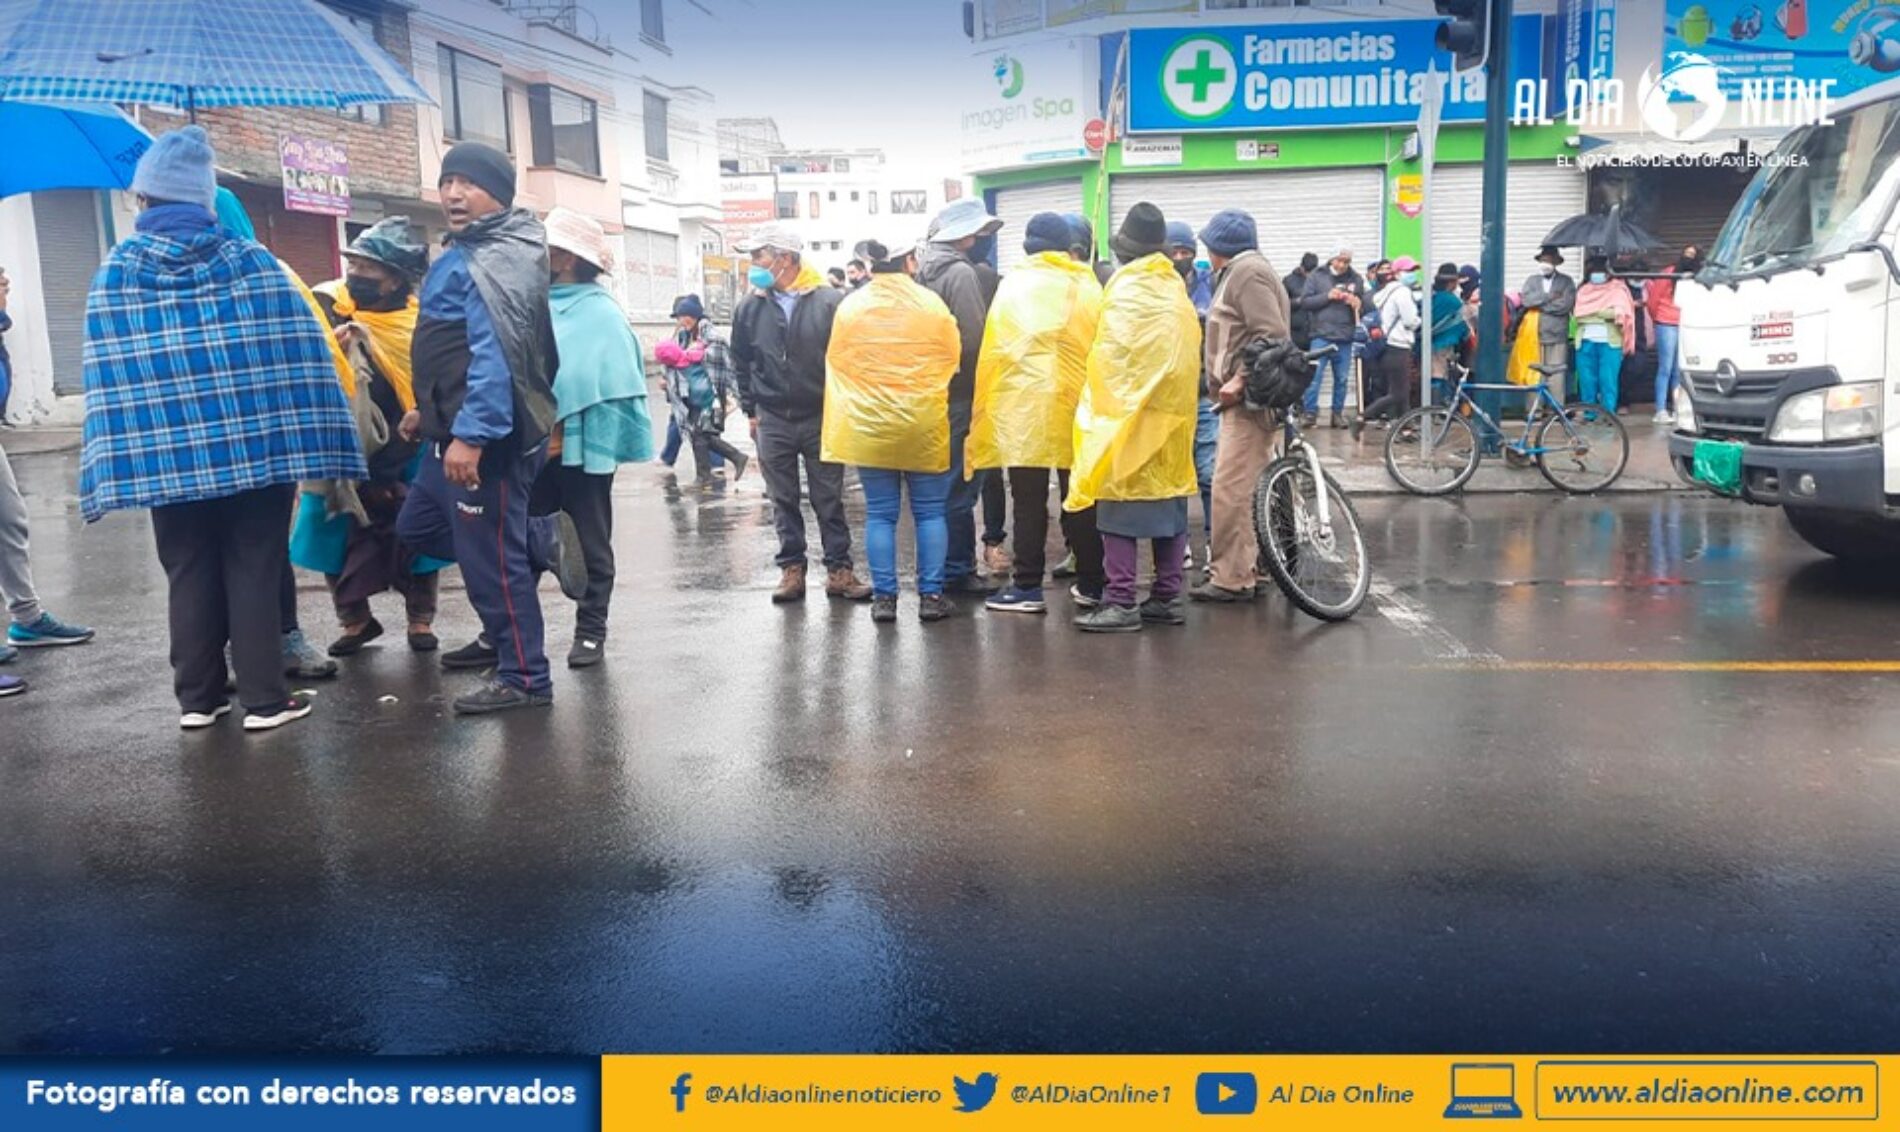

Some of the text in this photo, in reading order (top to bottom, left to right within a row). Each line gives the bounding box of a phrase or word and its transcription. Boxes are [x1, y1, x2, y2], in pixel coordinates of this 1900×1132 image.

[1244, 31, 1396, 66] Farmacias
[1032, 96, 1074, 120] Spa
[1766, 351, 1798, 365] 300
